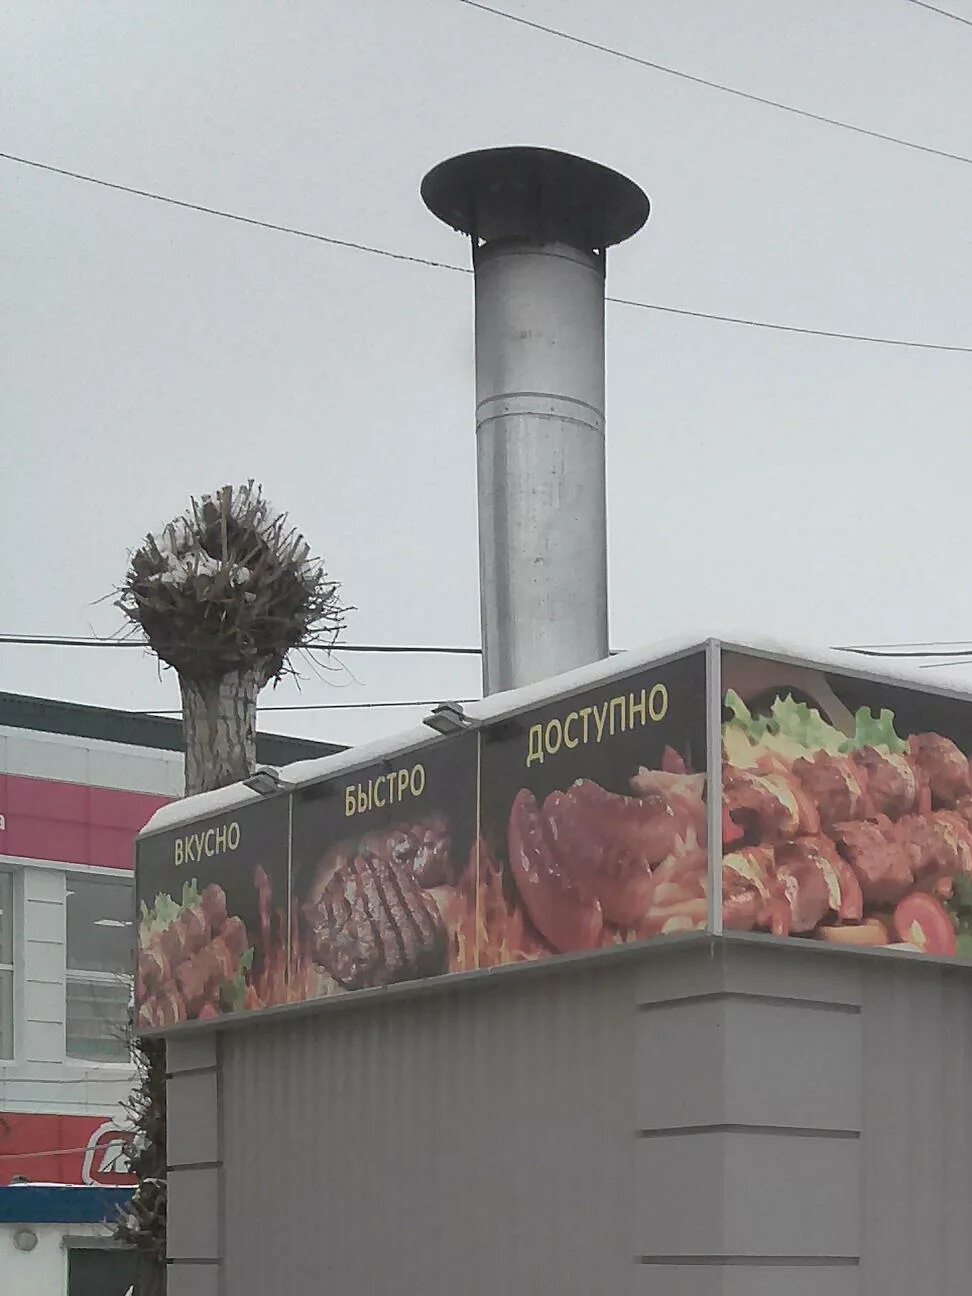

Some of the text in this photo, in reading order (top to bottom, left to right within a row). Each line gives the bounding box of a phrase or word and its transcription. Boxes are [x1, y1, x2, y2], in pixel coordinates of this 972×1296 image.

[526, 683, 669, 767] ДОСТУПНО
[344, 763, 426, 817] БЫСТРО
[174, 821, 241, 866] ВКУСНО
